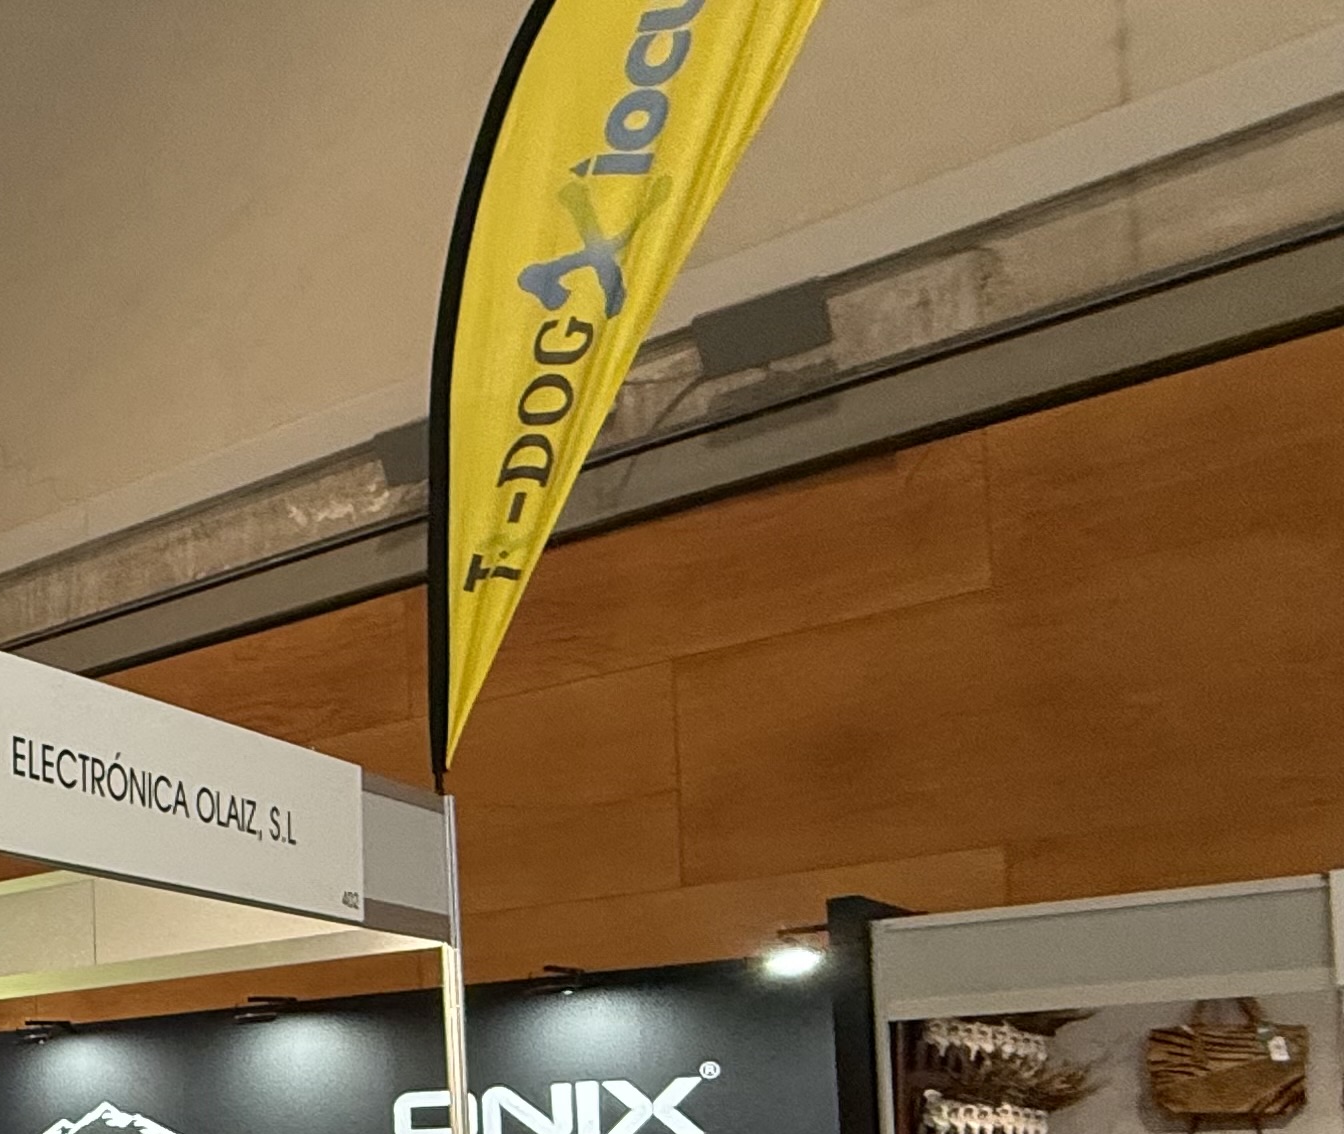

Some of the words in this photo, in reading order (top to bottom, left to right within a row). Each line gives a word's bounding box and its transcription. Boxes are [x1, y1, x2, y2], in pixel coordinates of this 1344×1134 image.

[11, 736, 189, 817] ELECTRÓNICA
[195, 785, 263, 841] OLAIZ,
[269, 800, 297, 845] S.L
